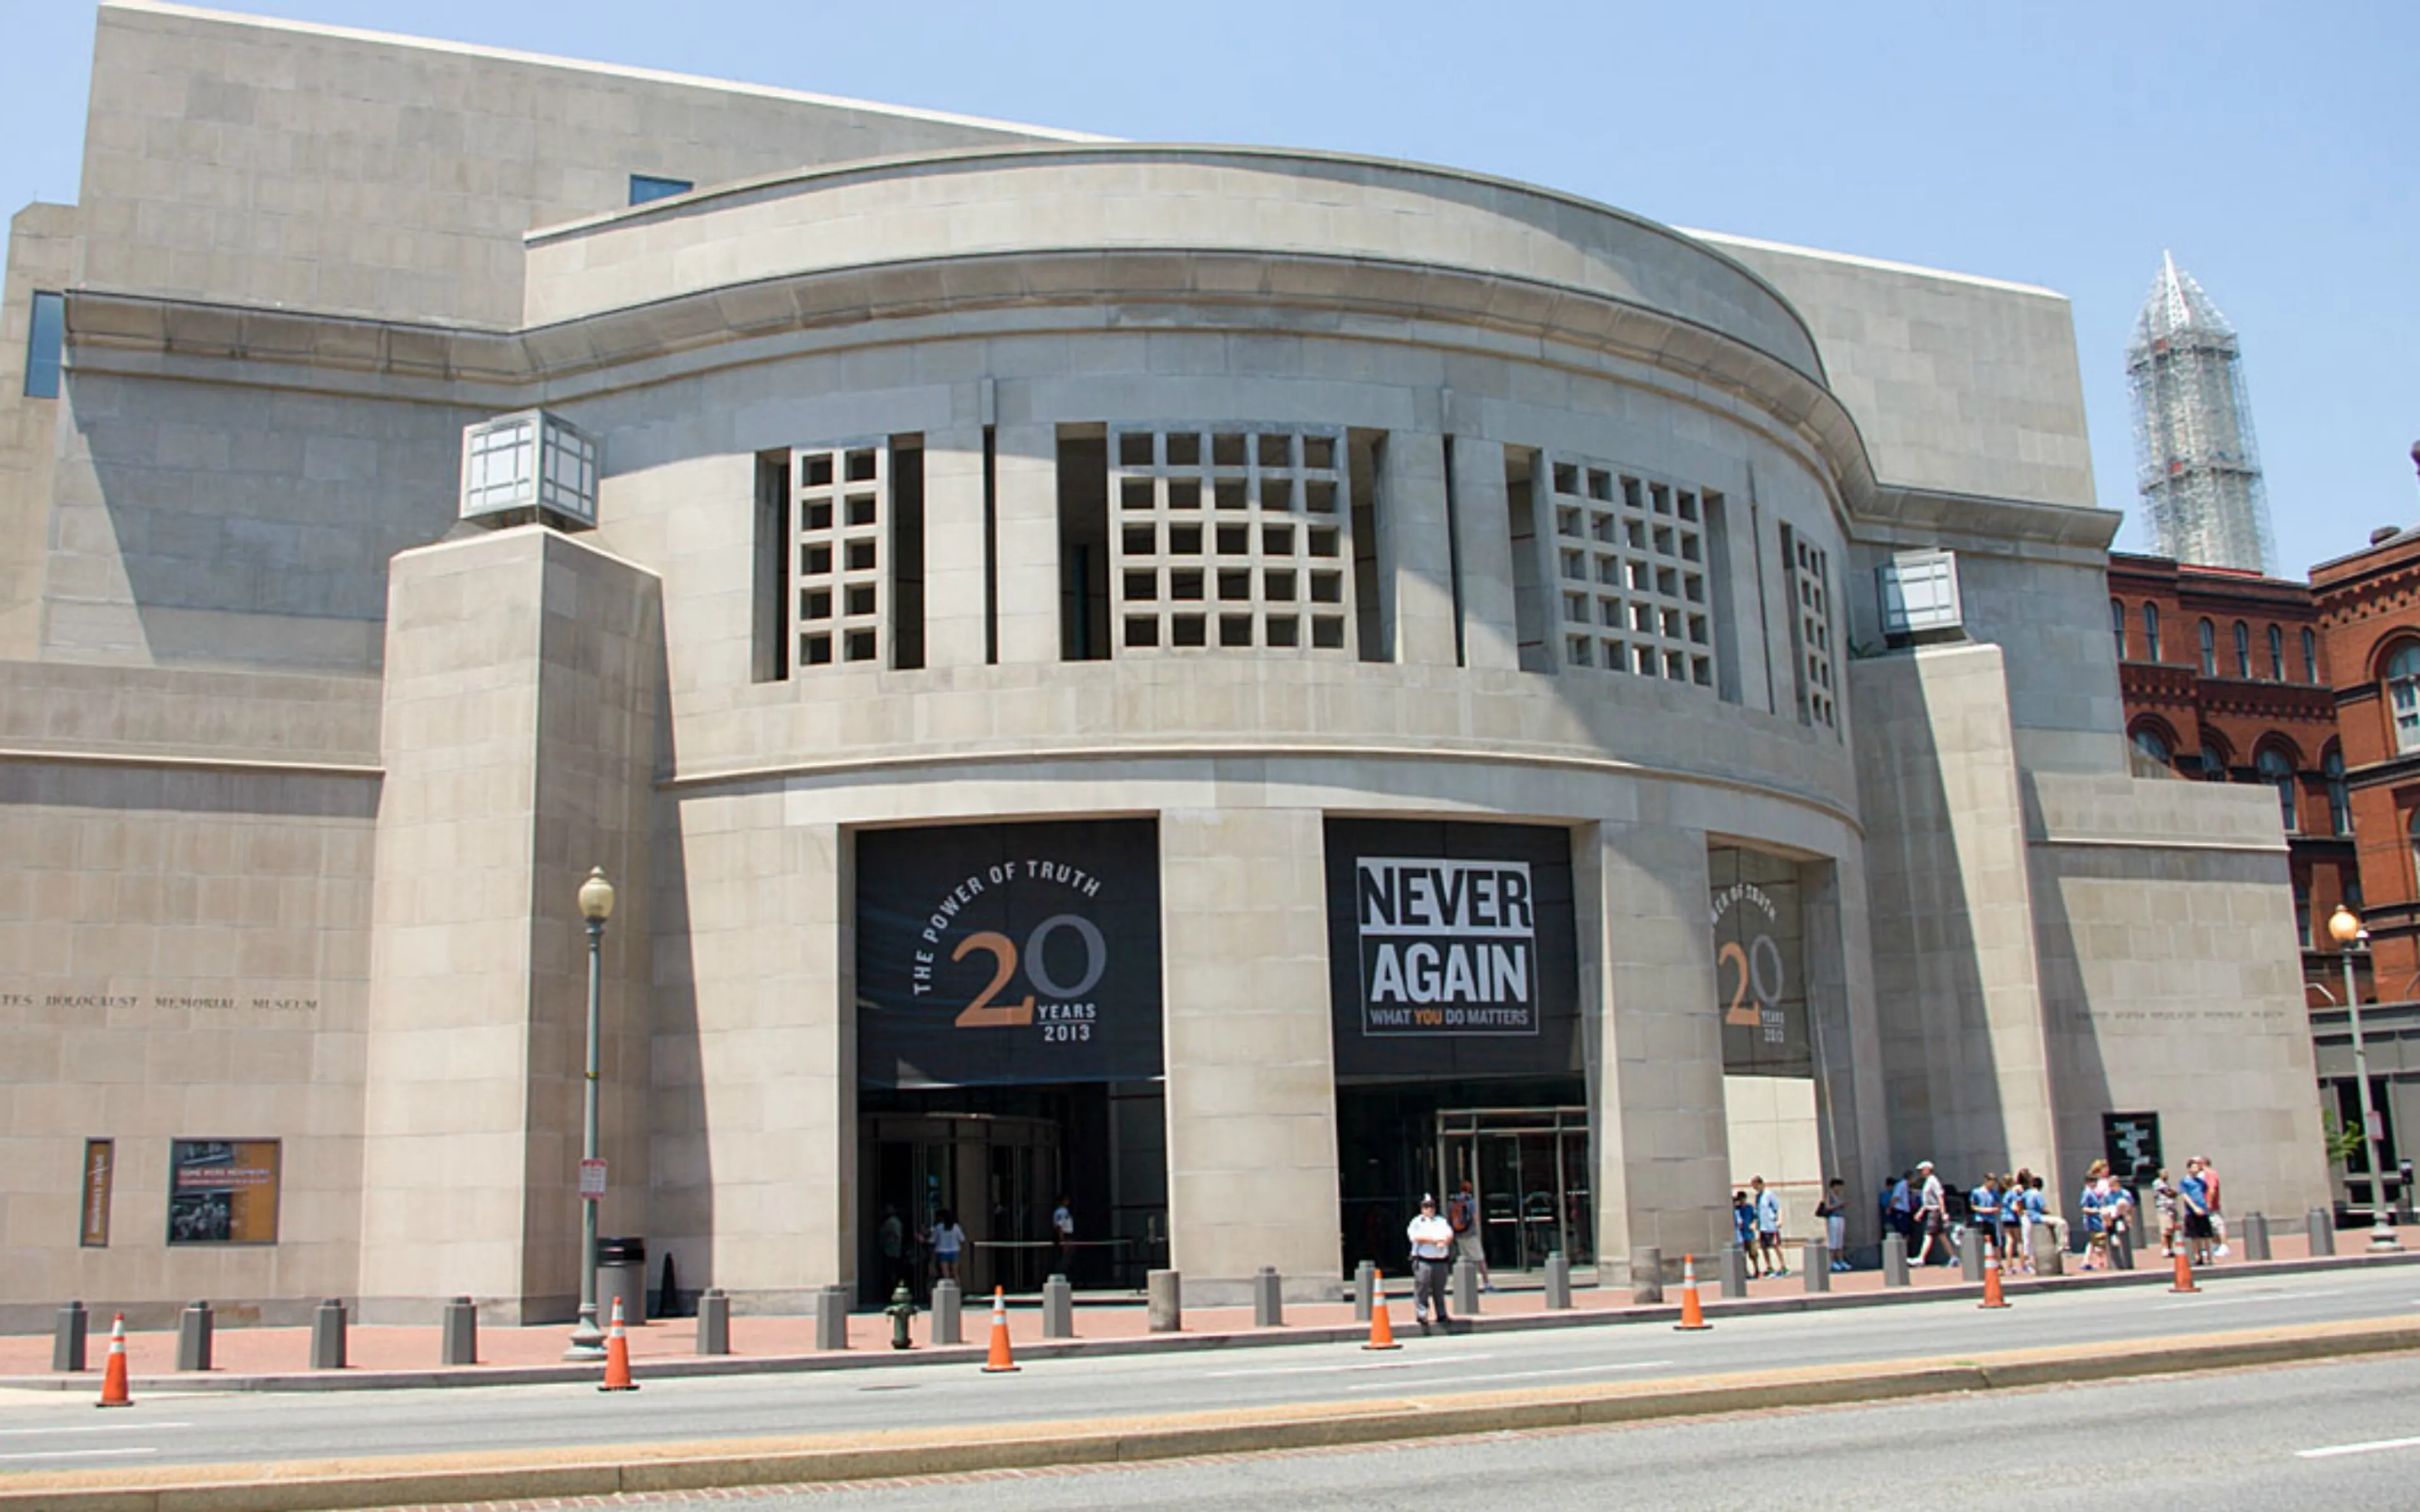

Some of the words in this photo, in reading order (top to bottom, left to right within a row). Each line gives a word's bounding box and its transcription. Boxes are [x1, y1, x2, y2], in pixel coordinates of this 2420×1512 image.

[989, 862, 1017, 883] OF
[1026, 860, 1102, 897] TRUTH
[923, 876, 985, 944] POWER
[1359, 866, 1533, 928] NEVER
[914, 950, 934, 995] THE
[951, 914, 1107, 1028] 20
[1370, 942, 1528, 1004] AGAIN
[1718, 934, 1785, 1026] 20
[1037, 1003, 1097, 1019] YEARS
[1044, 1024, 1090, 1041] 2013
[1370, 1009, 1412, 1025] WHAT
[1414, 1009, 1443, 1025] YOU
[1445, 1009, 1465, 1025] DO
[1466, 1009, 1529, 1025] MATTERS
